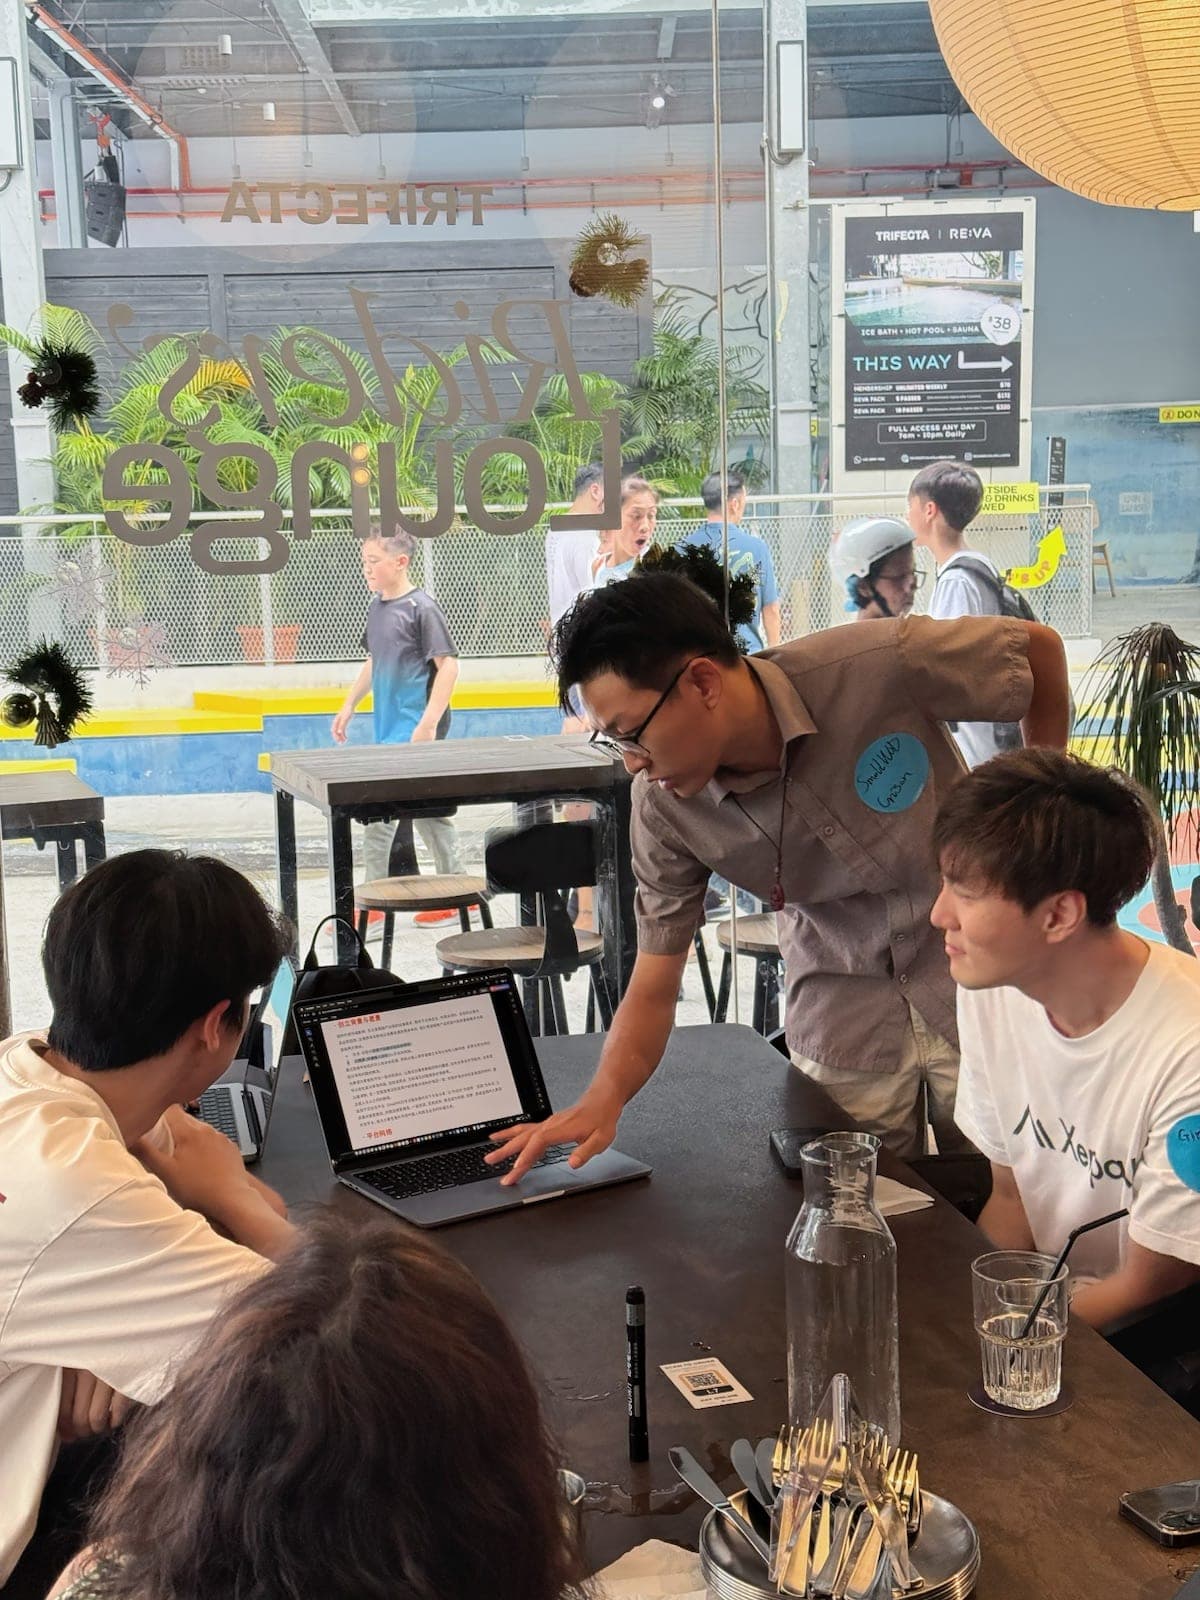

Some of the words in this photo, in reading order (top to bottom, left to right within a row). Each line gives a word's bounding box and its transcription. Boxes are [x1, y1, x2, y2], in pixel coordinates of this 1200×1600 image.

[875, 229, 930, 241] TRIFECTA
[877, 328, 898, 336] BATH
[852, 356, 902, 371] THIS
[908, 354, 952, 369] WAY
[1177, 410, 1193, 419] DO
[945, 431, 966, 439] Daily
[986, 485, 1018, 494] TSIDE
[994, 493, 1034, 502] DRINKS
